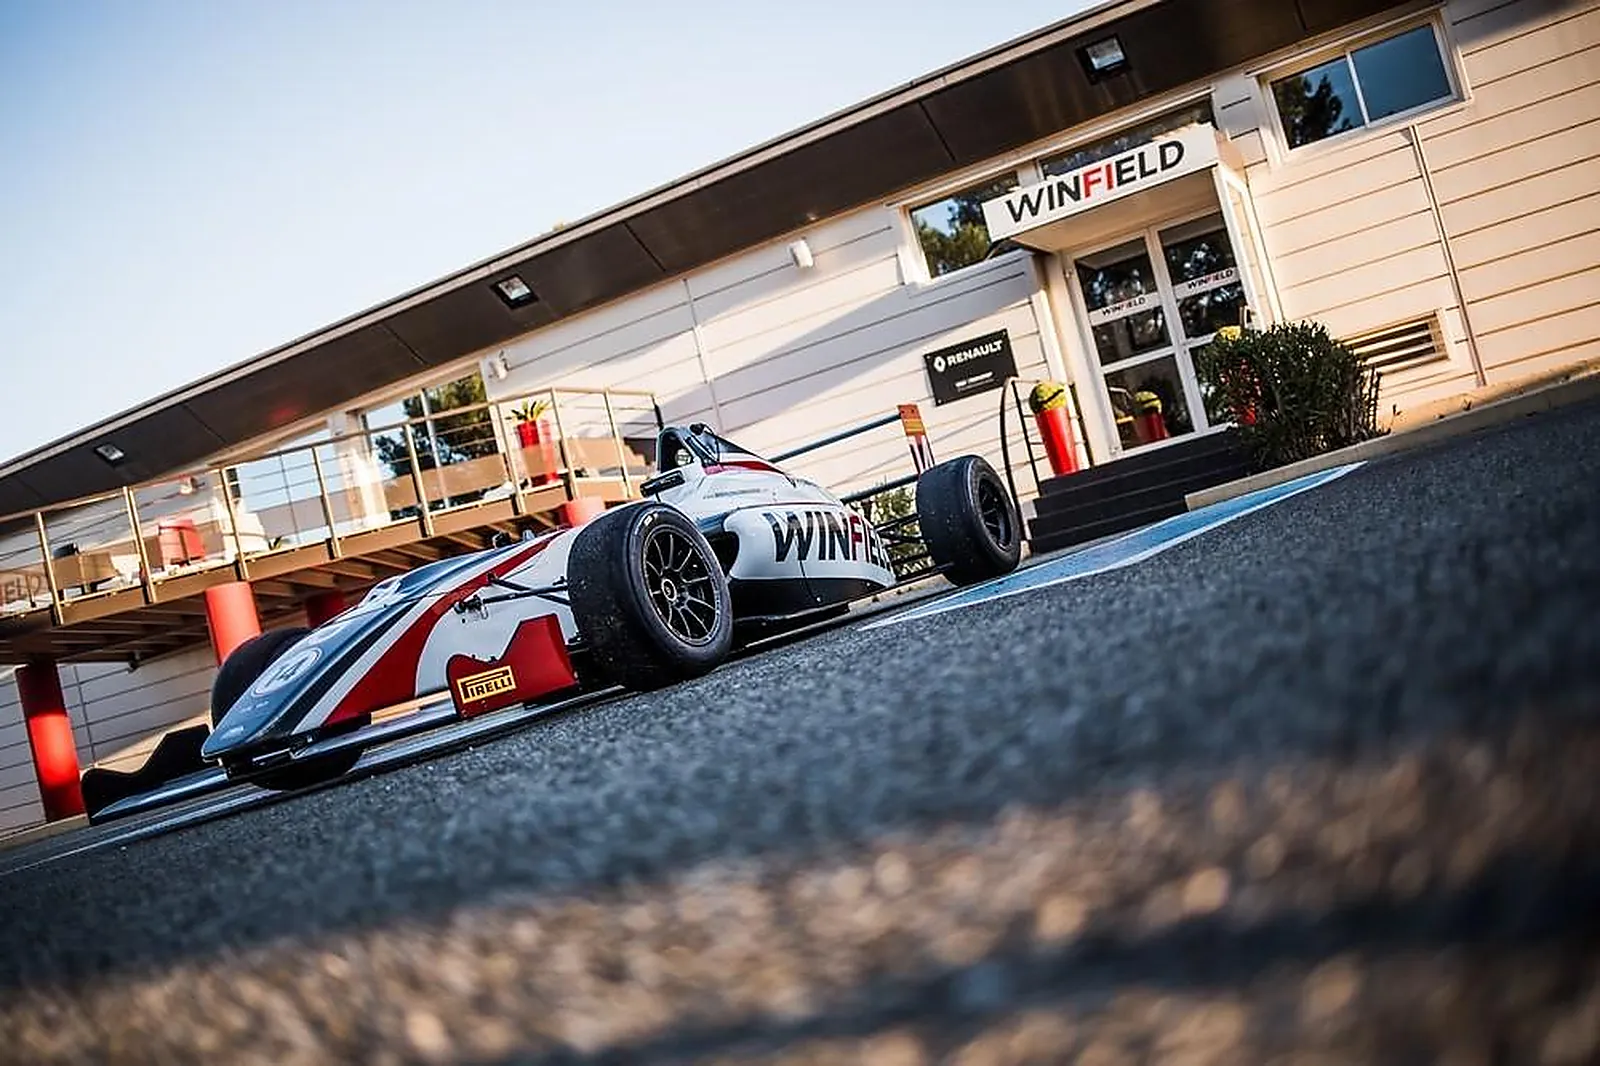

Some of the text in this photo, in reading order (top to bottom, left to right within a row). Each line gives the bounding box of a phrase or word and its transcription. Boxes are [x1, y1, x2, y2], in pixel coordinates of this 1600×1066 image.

[1006, 140, 1185, 223] WINFIELD
[947, 340, 1003, 366] RENAULT
[461, 669, 513, 699] PIRELLI
